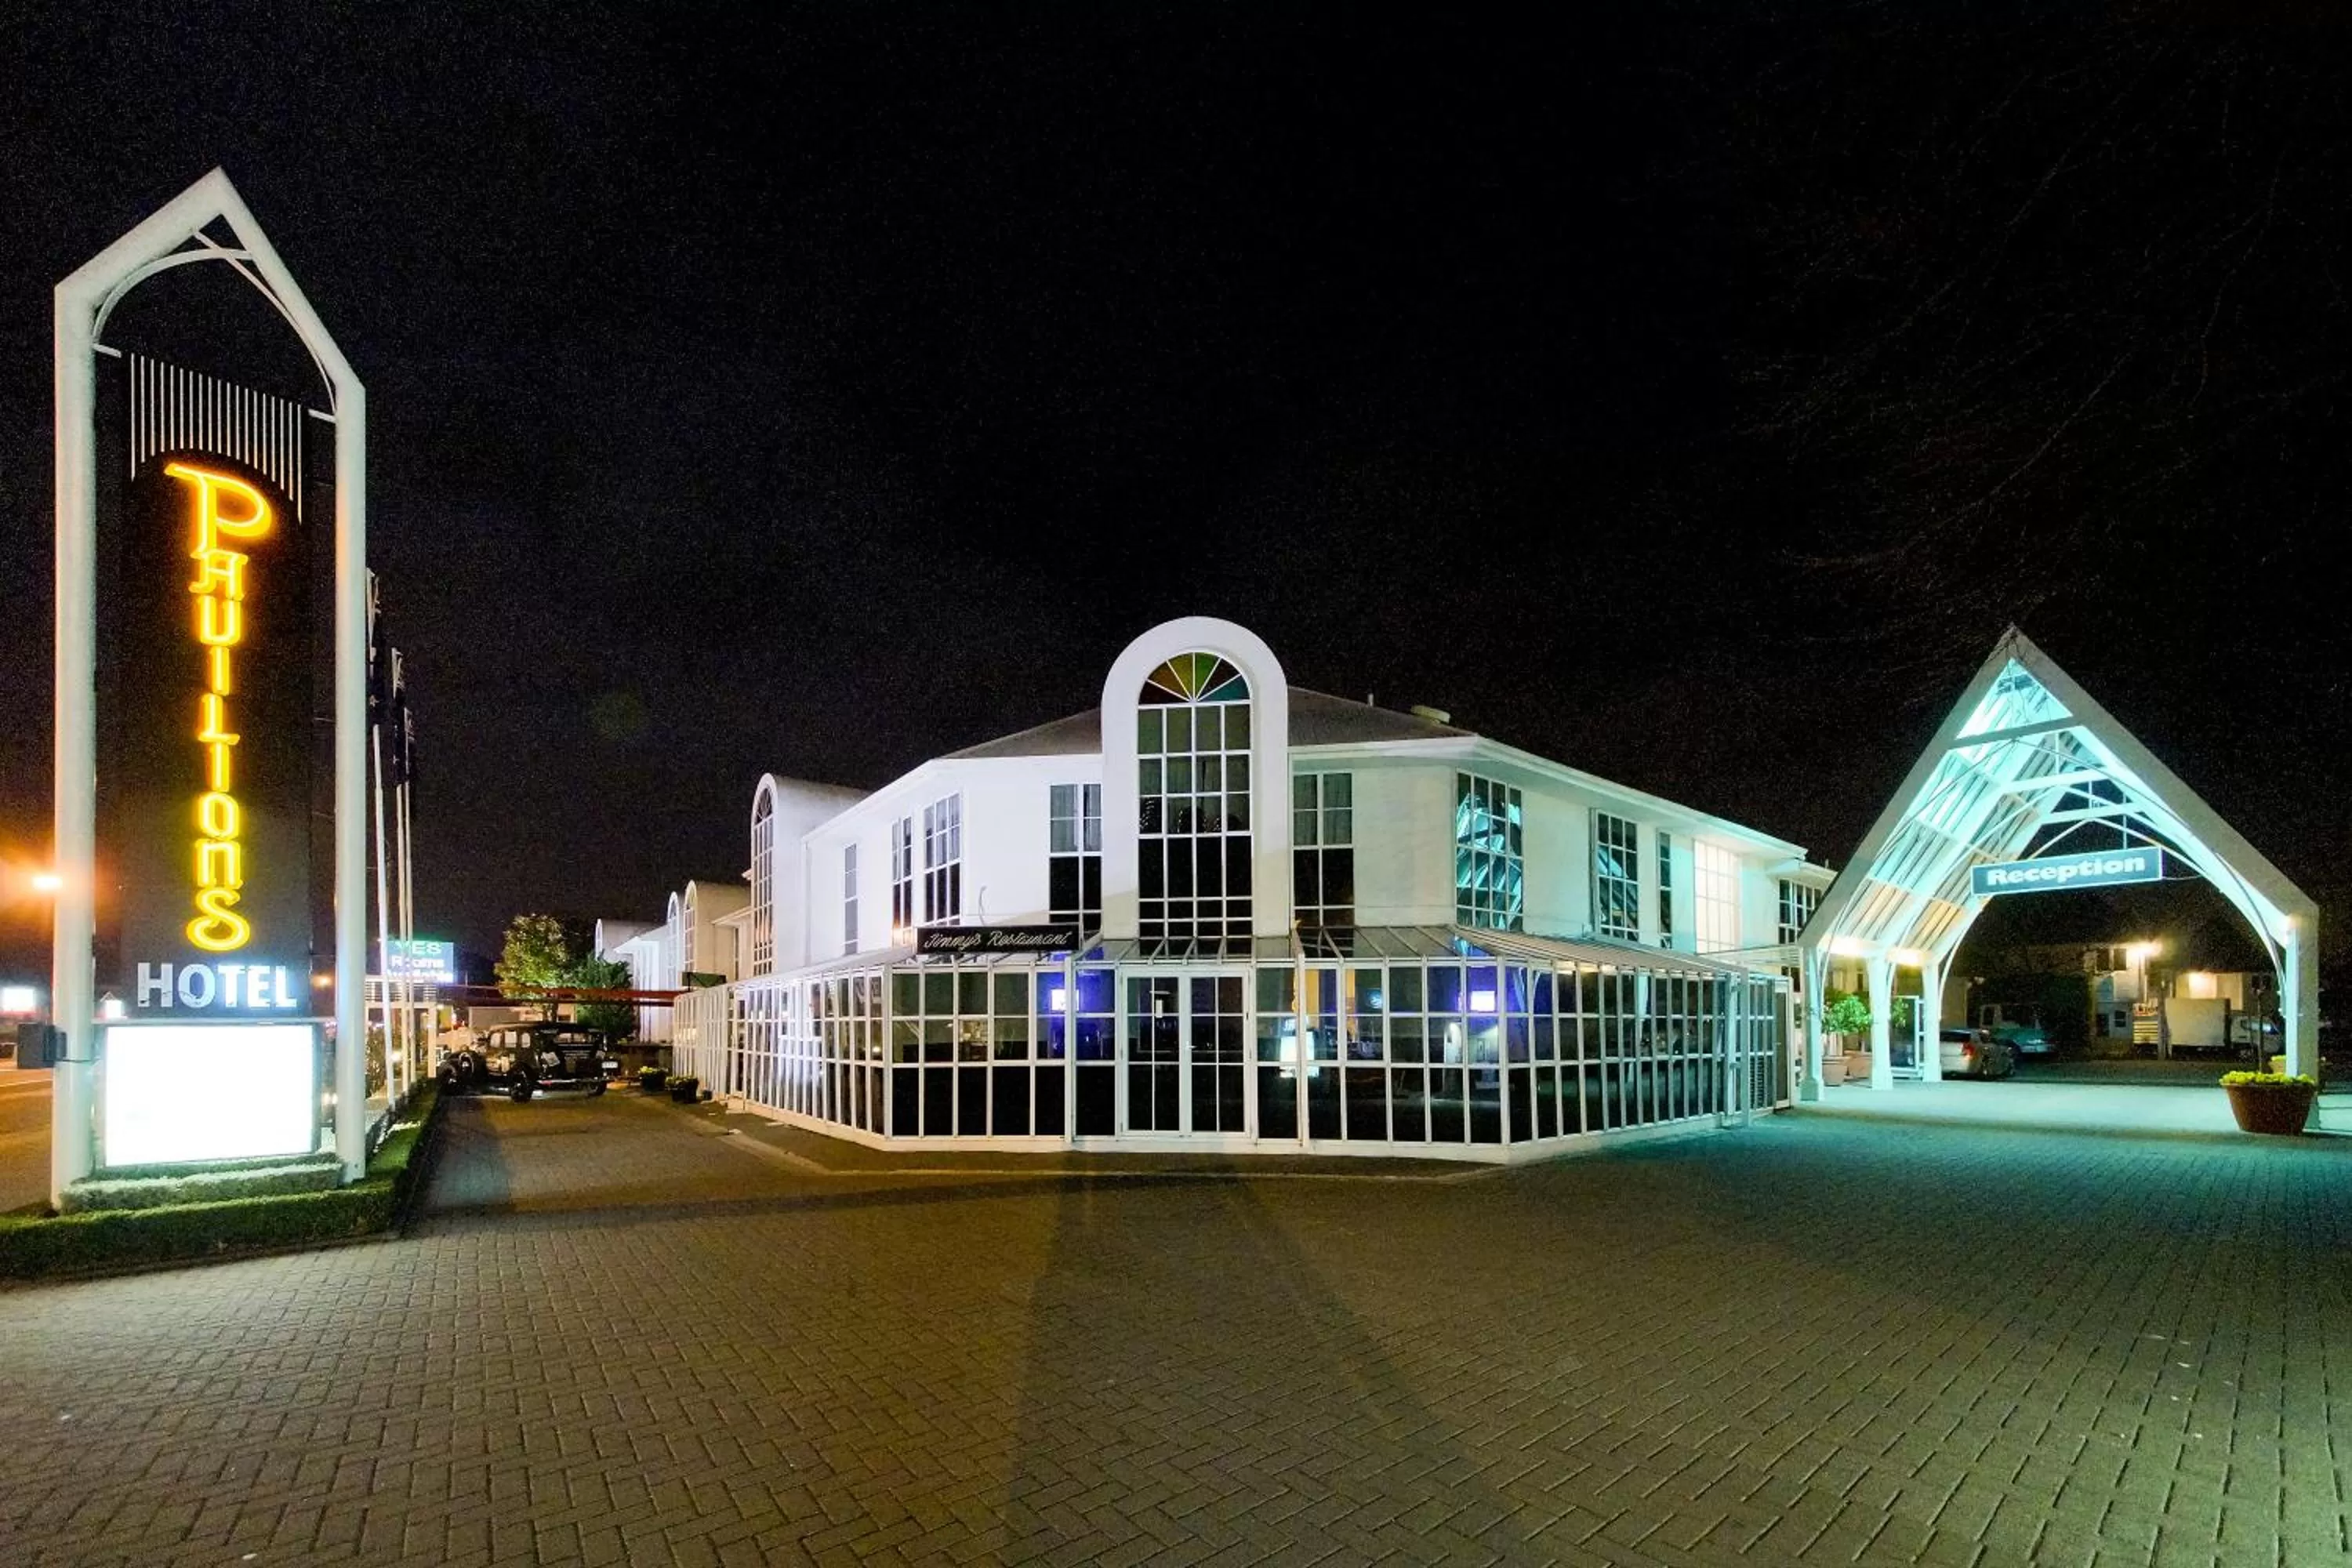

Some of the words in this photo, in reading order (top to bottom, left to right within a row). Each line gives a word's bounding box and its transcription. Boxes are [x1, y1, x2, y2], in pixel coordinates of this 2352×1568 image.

[1987, 854, 2147, 884] Reception
[924, 933, 982, 951] Jimmy's
[988, 930, 1073, 947] Restaurant
[136, 961, 298, 1008] HOTEL
